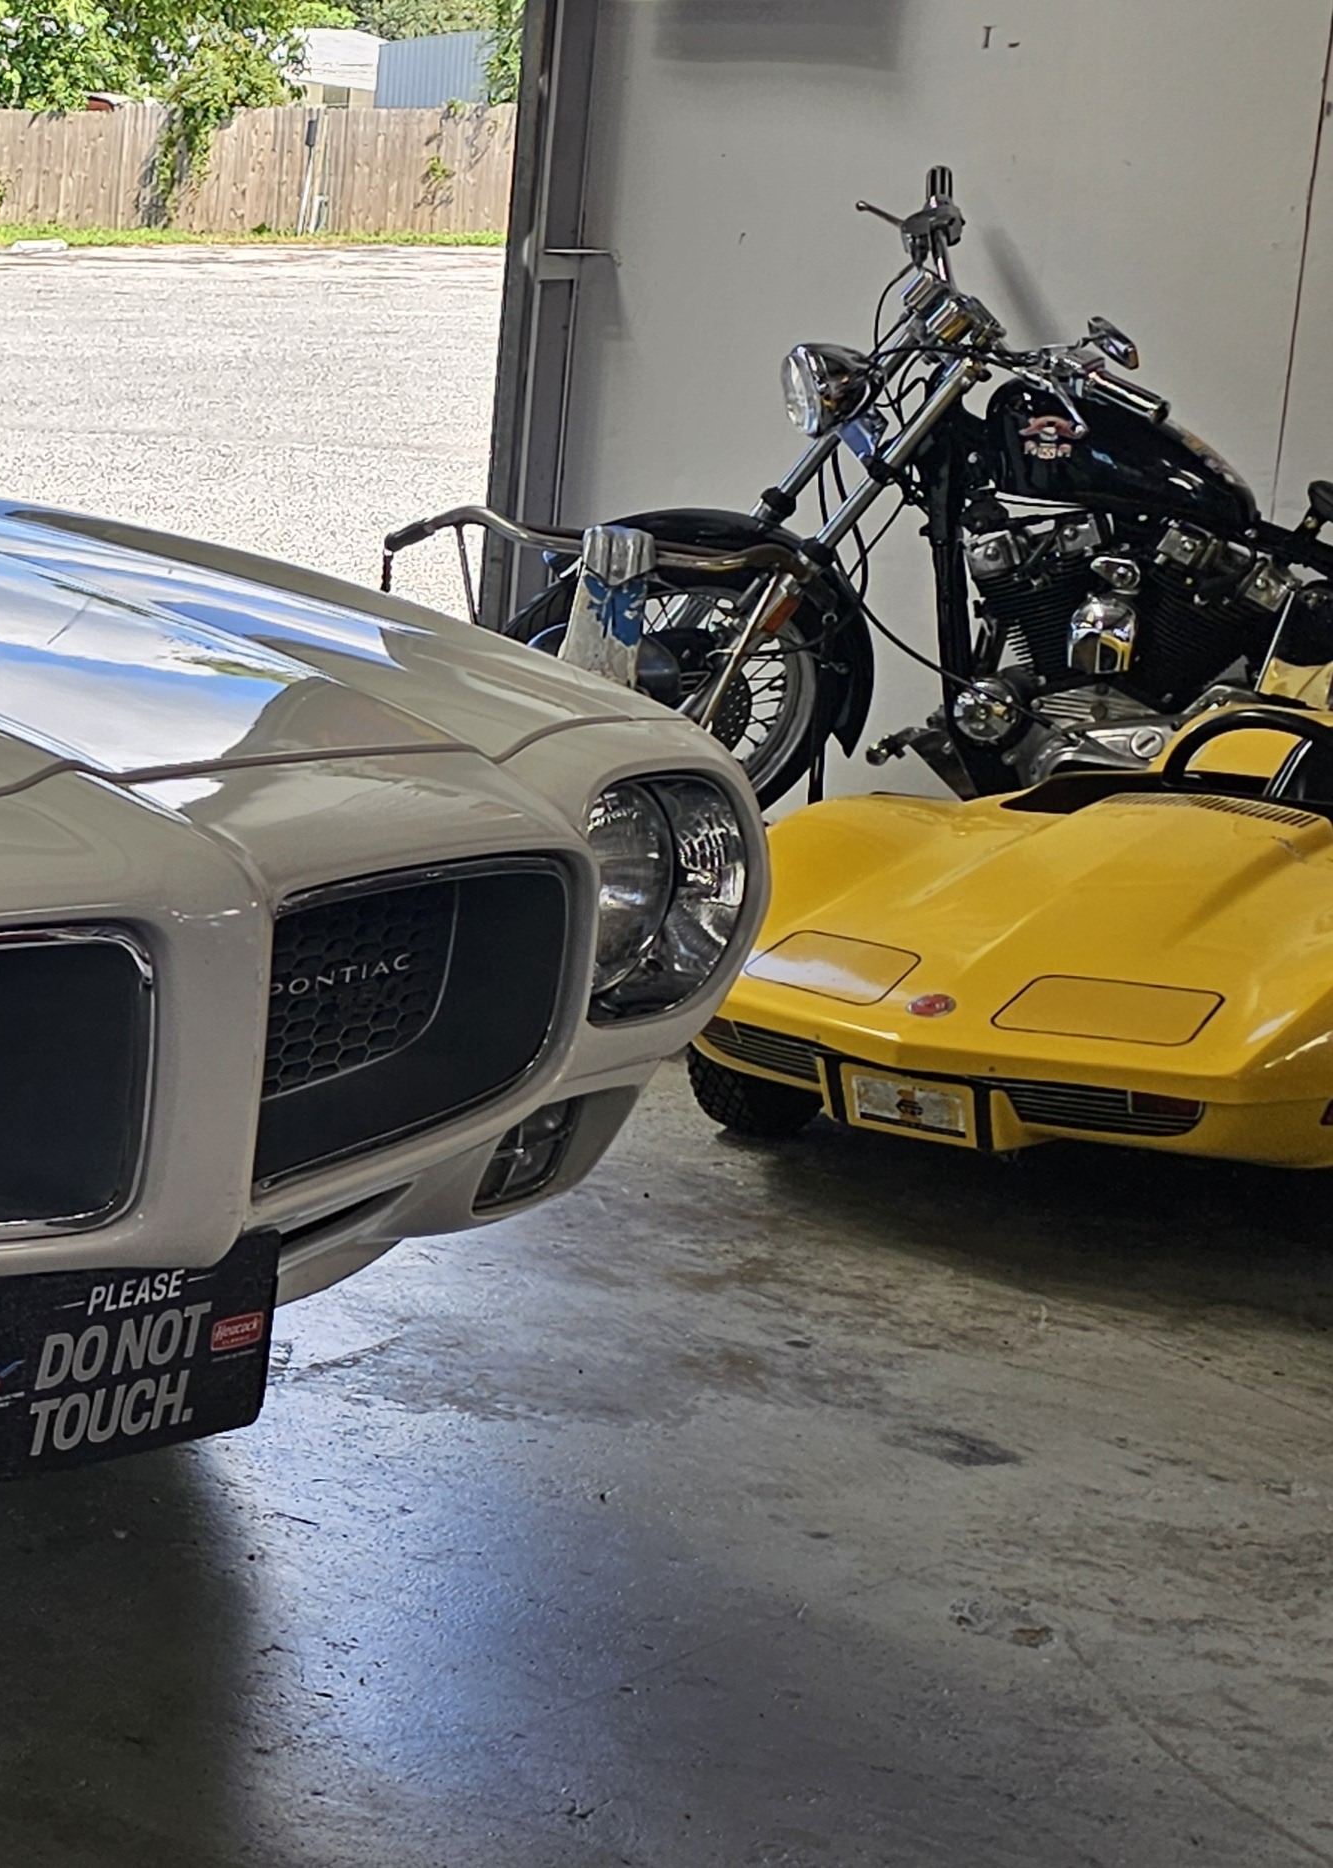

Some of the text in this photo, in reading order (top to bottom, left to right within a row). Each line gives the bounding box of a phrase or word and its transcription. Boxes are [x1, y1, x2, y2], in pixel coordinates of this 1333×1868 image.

[87, 1269, 185, 1316] PLEASE
[34, 1301, 213, 1391] DO NOT
[29, 1369, 194, 1457] TOUCH.
